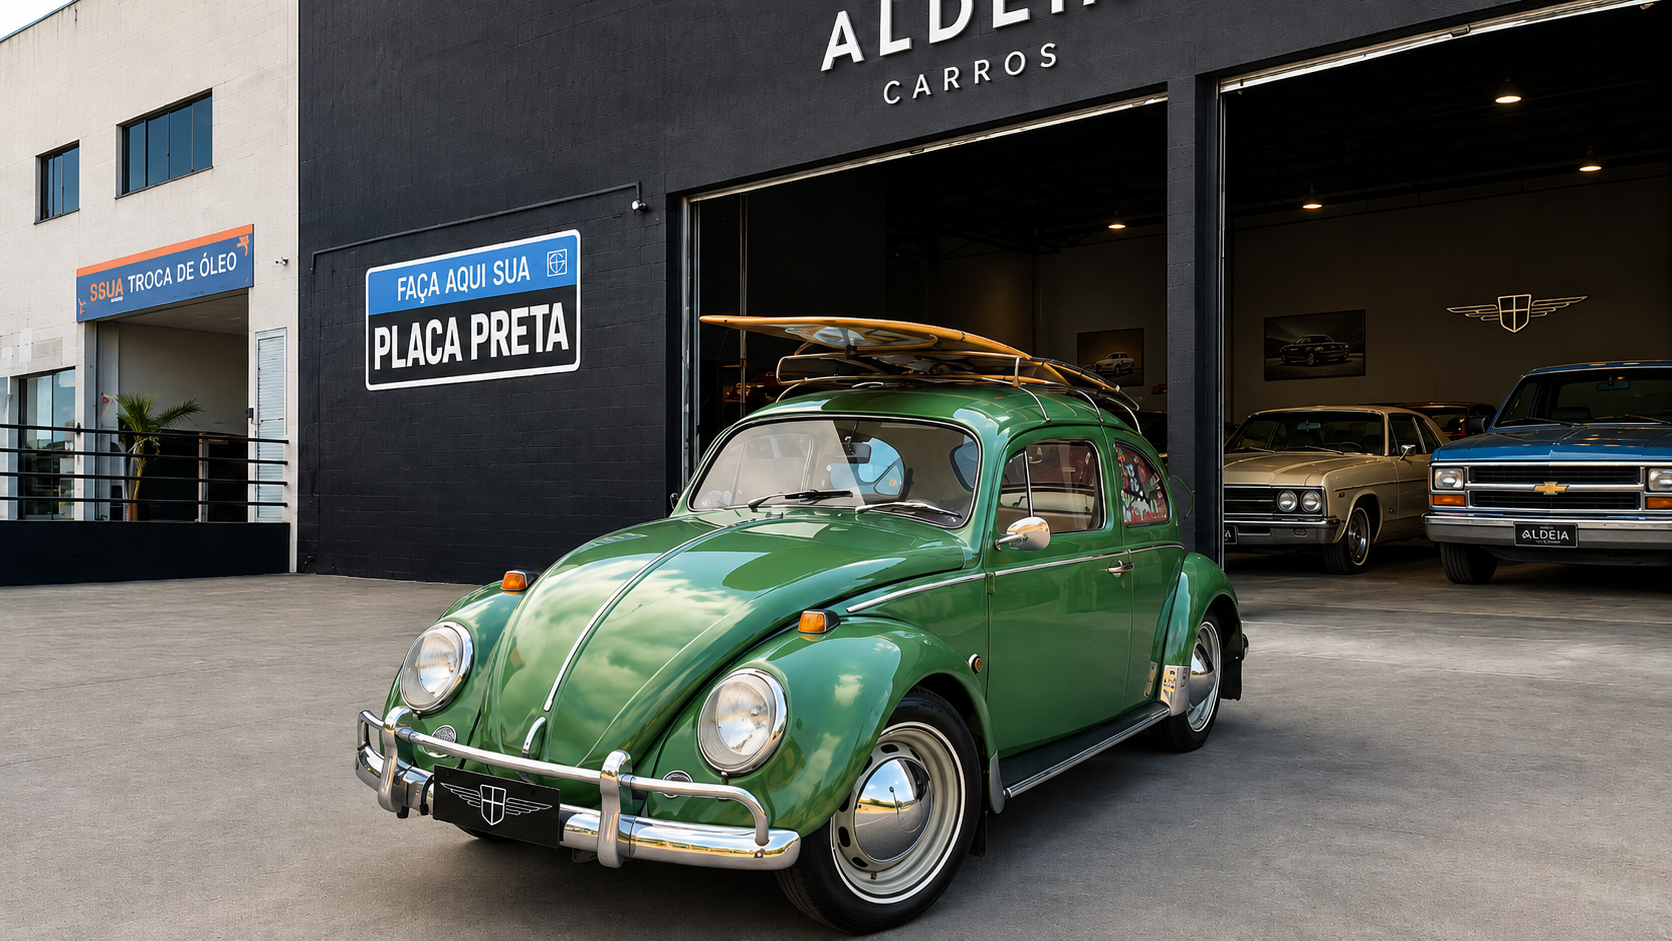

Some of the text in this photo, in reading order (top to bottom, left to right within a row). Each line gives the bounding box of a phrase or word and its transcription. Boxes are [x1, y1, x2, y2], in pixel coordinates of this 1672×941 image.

[883, 42, 1057, 105] CARROS
[90, 251, 237, 302] SSUA TROCA DE ÓLEO
[397, 255, 531, 304] FAÇA AQUI SUA
[374, 302, 569, 371] PLACA PRETA
[1521, 529, 1570, 541] ALDEIA
